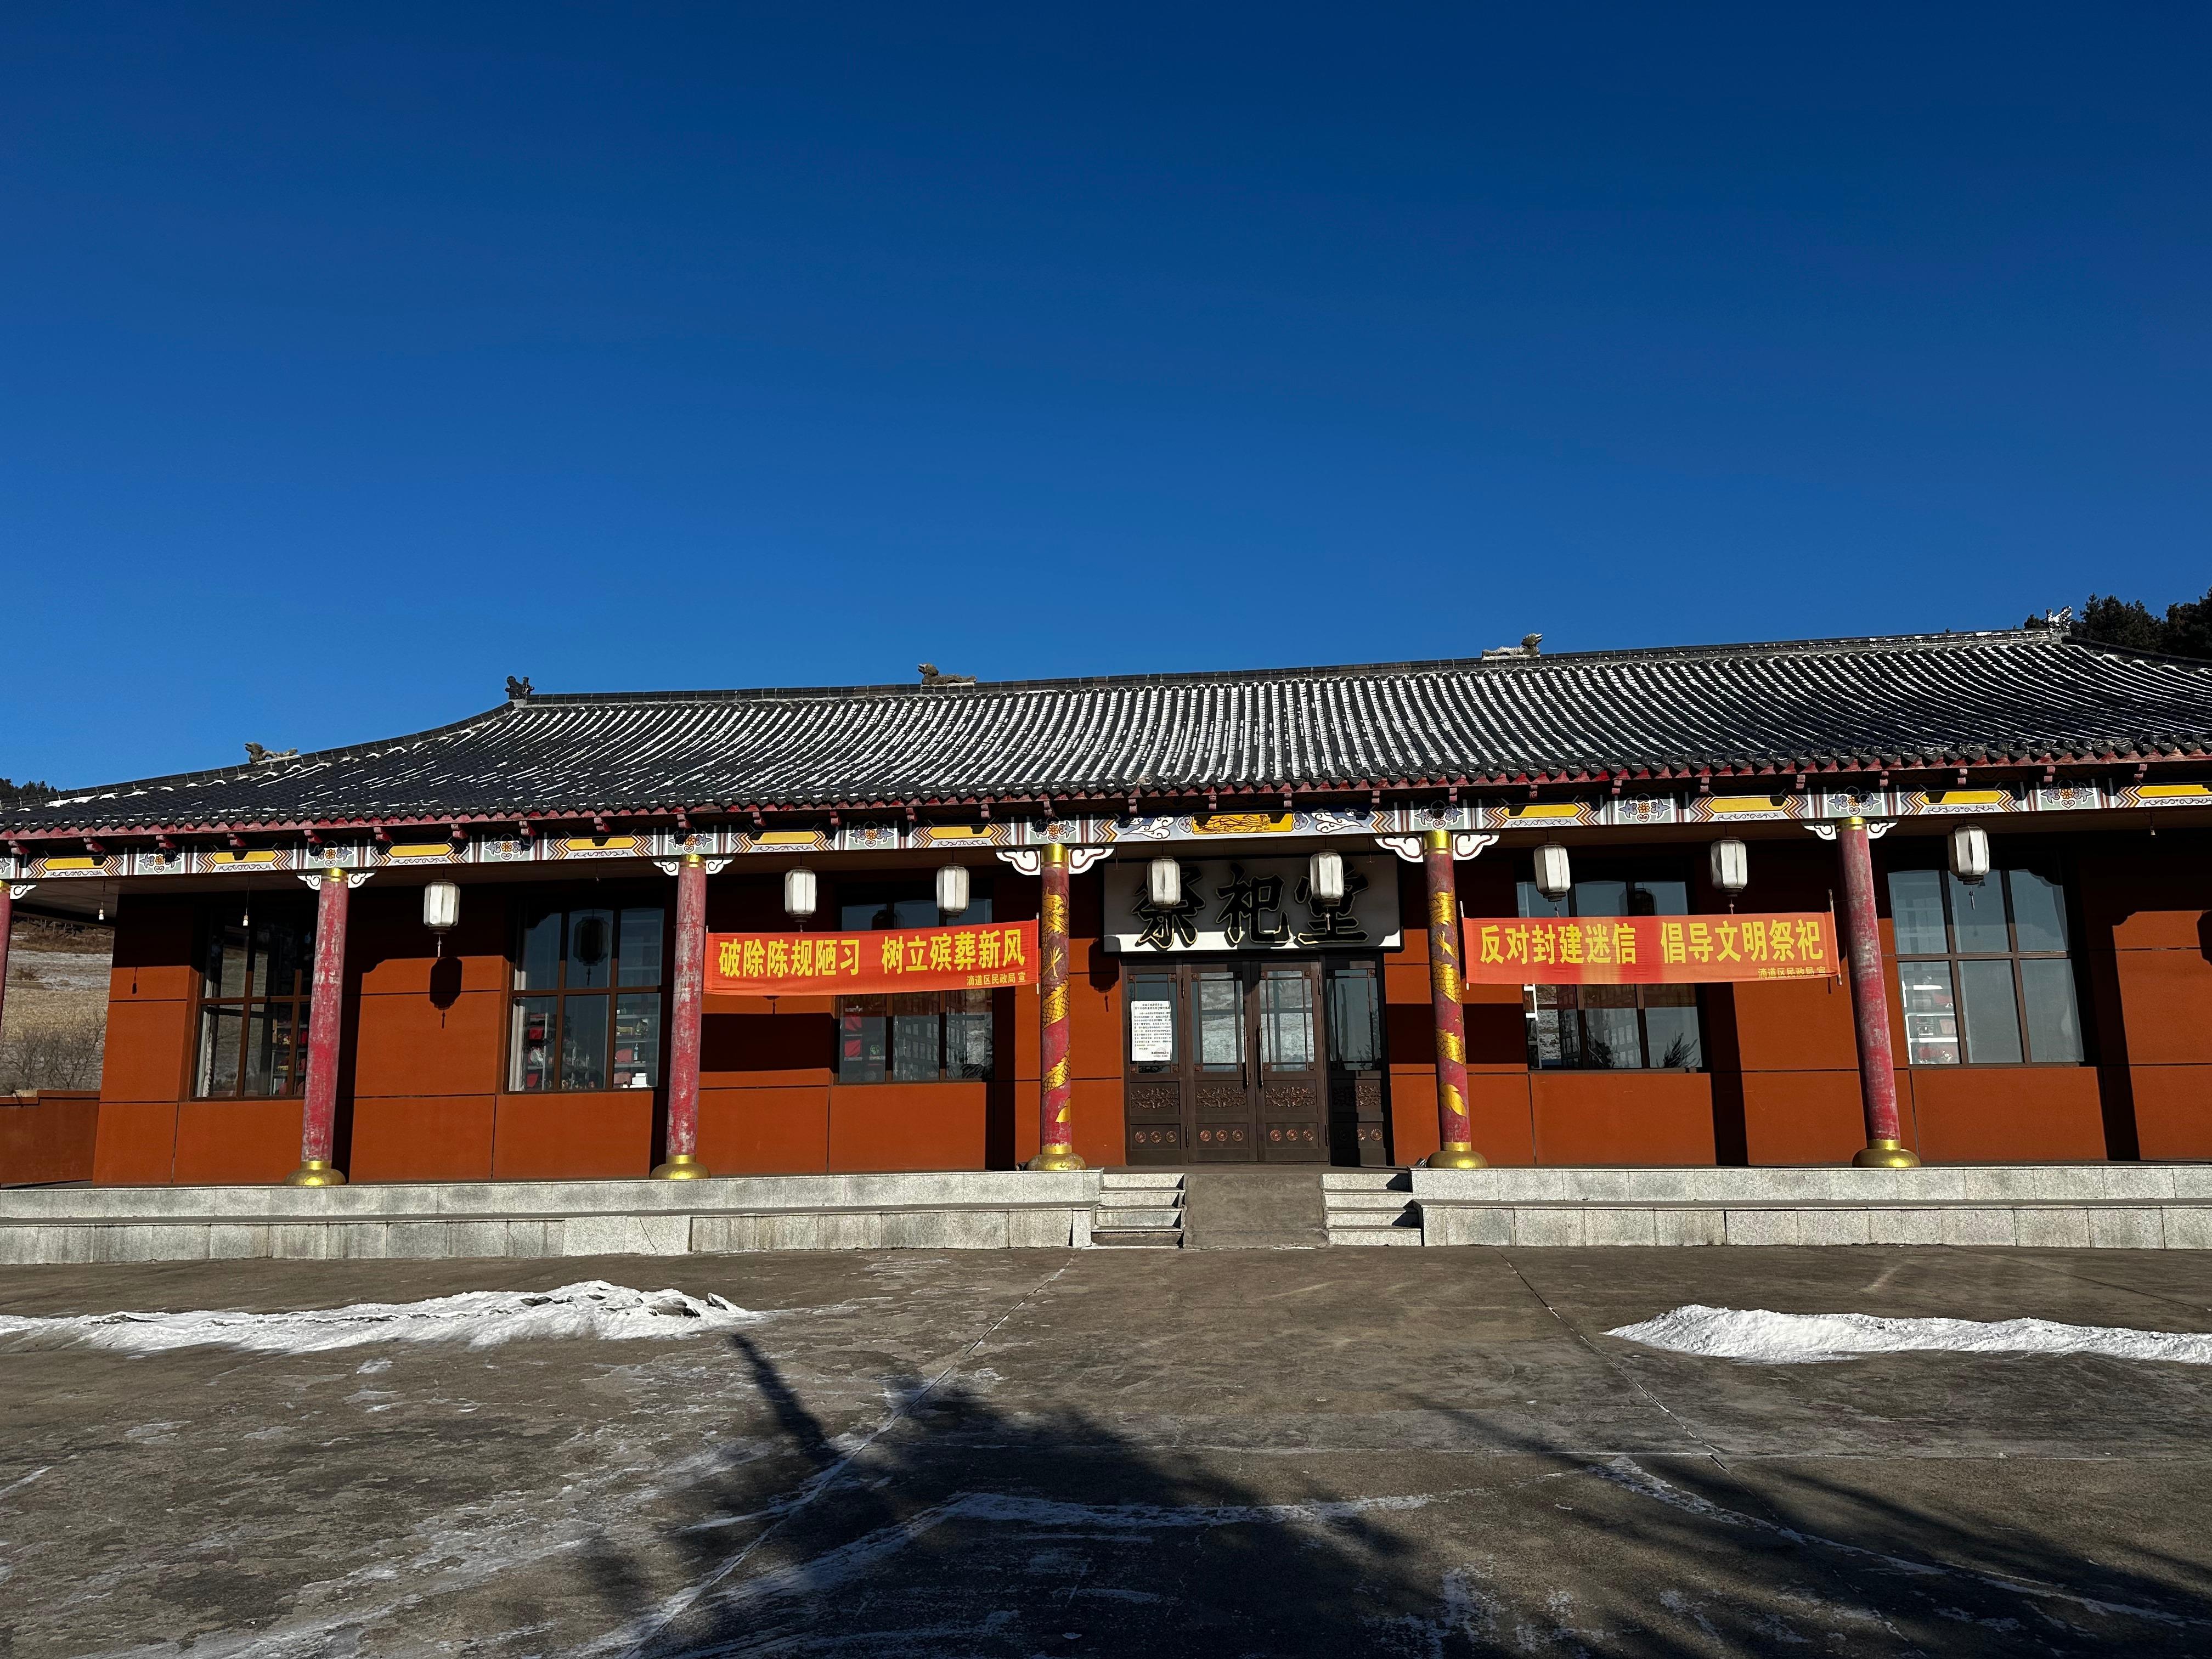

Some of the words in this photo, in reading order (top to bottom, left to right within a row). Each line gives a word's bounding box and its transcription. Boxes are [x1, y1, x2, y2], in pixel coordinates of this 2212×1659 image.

[718, 938, 860, 978] 破除陈规陋习
[881, 928, 1025, 974] 树立殡葬新风
[1480, 922, 1637, 964] 反对封建迷信
[1660, 918, 1824, 963] 倡导文明祭祀
[966, 973, 1015, 986] 滴道区民政局
[1018, 971, 1026, 983] 宣
